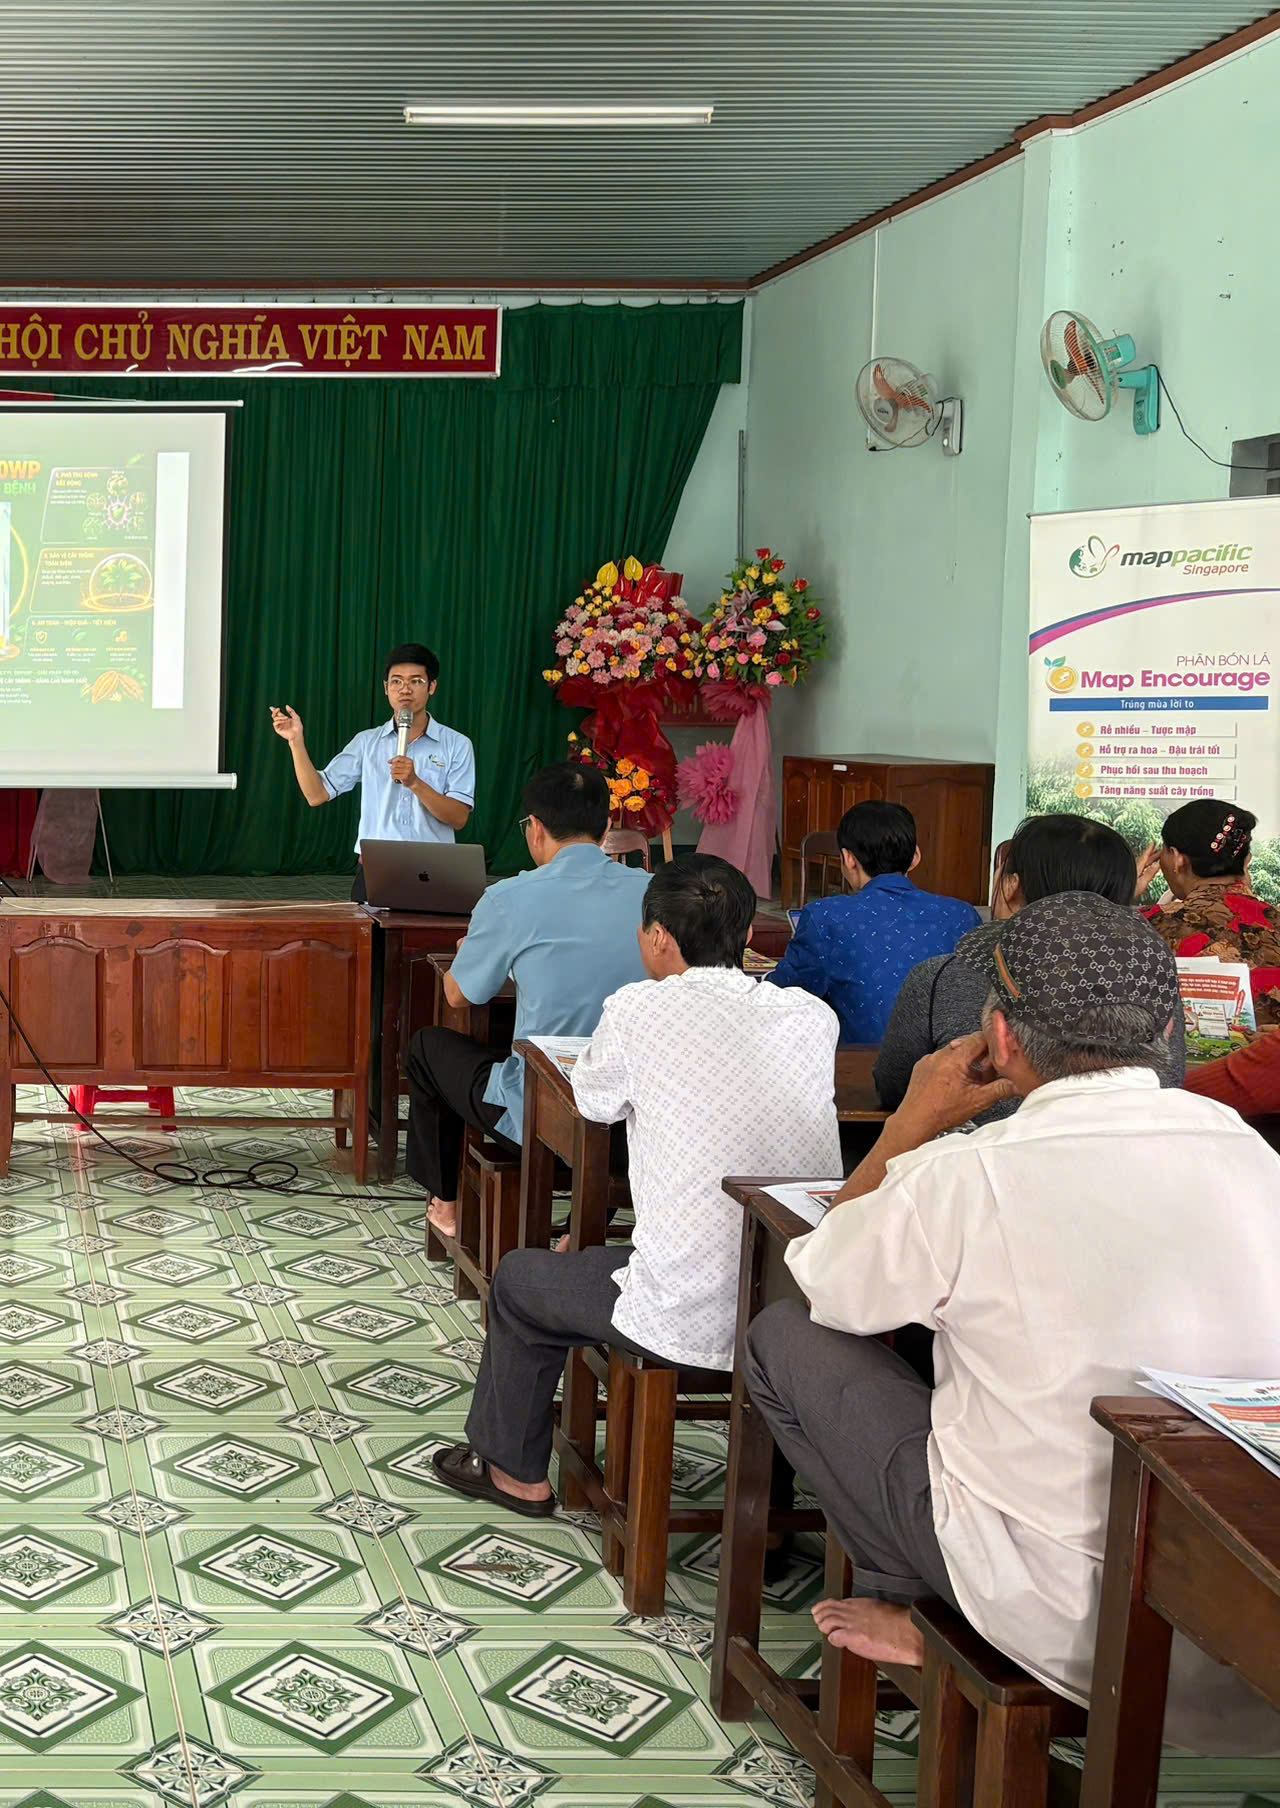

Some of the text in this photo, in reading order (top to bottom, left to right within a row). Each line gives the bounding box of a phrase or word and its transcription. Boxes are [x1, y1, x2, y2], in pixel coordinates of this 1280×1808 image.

[74, 310, 153, 360] CHỦ
[166, 315, 290, 360] NGHĨA
[297, 314, 388, 367] VIỆT
[402, 325, 486, 360] NAM
[4, 480, 36, 496] BỆNH
[1120, 544, 1253, 568] mappacific
[1182, 563, 1249, 576] Singapore
[1177, 651, 1271, 667] PHÂN BÓN LÁ
[1080, 669, 1271, 692] Map Encourage
[1120, 699, 1145, 711] Trúng
[1148, 699, 1168, 708] mùa
[1185, 700, 1195, 708] to
[1151, 725, 1174, 736] Tược
[1176, 724, 1197, 736] mập
[1129, 746, 1138, 754] ra
[1141, 745, 1158, 754] hoa
[1169, 745, 1187, 756] Đậu
[1189, 745, 1205, 754] trái
[1208, 744, 1220, 754] tốt
[1101, 765, 1124, 776] Phục
[1143, 767, 1159, 775] sau
[1162, 765, 1177, 775] thu
[1179, 766, 1208, 777] hoạch
[1099, 784, 1214, 797] Tăng năng suất cây trồng
